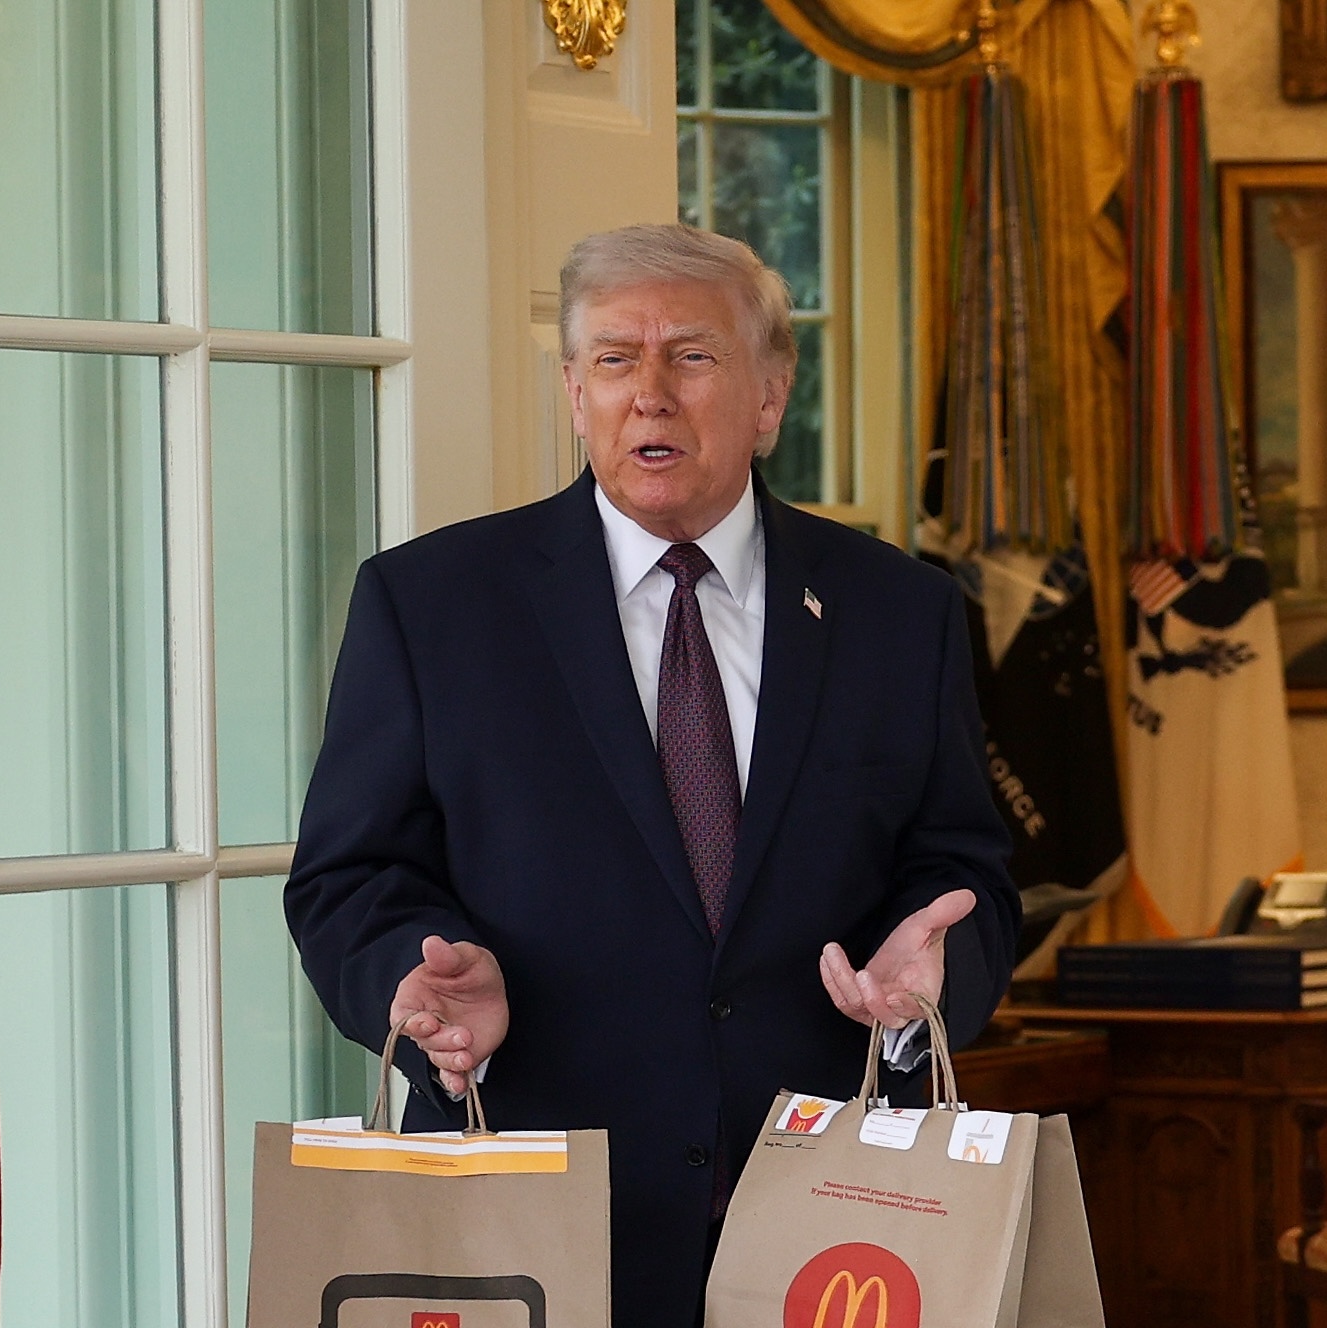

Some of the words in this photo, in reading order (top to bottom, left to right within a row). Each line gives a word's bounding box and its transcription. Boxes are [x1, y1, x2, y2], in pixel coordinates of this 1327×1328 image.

[984, 741, 1046, 838] ORCE
[824, 1181, 844, 1189] Please
[845, 1185, 870, 1193] contact
[887, 1191, 913, 1202] delivery
[914, 1197, 941, 1205] provider
[832, 1191, 843, 1199] bag
[857, 1195, 873, 1203] been
[875, 1199, 899, 1208] opened
[901, 1202, 922, 1212] before
